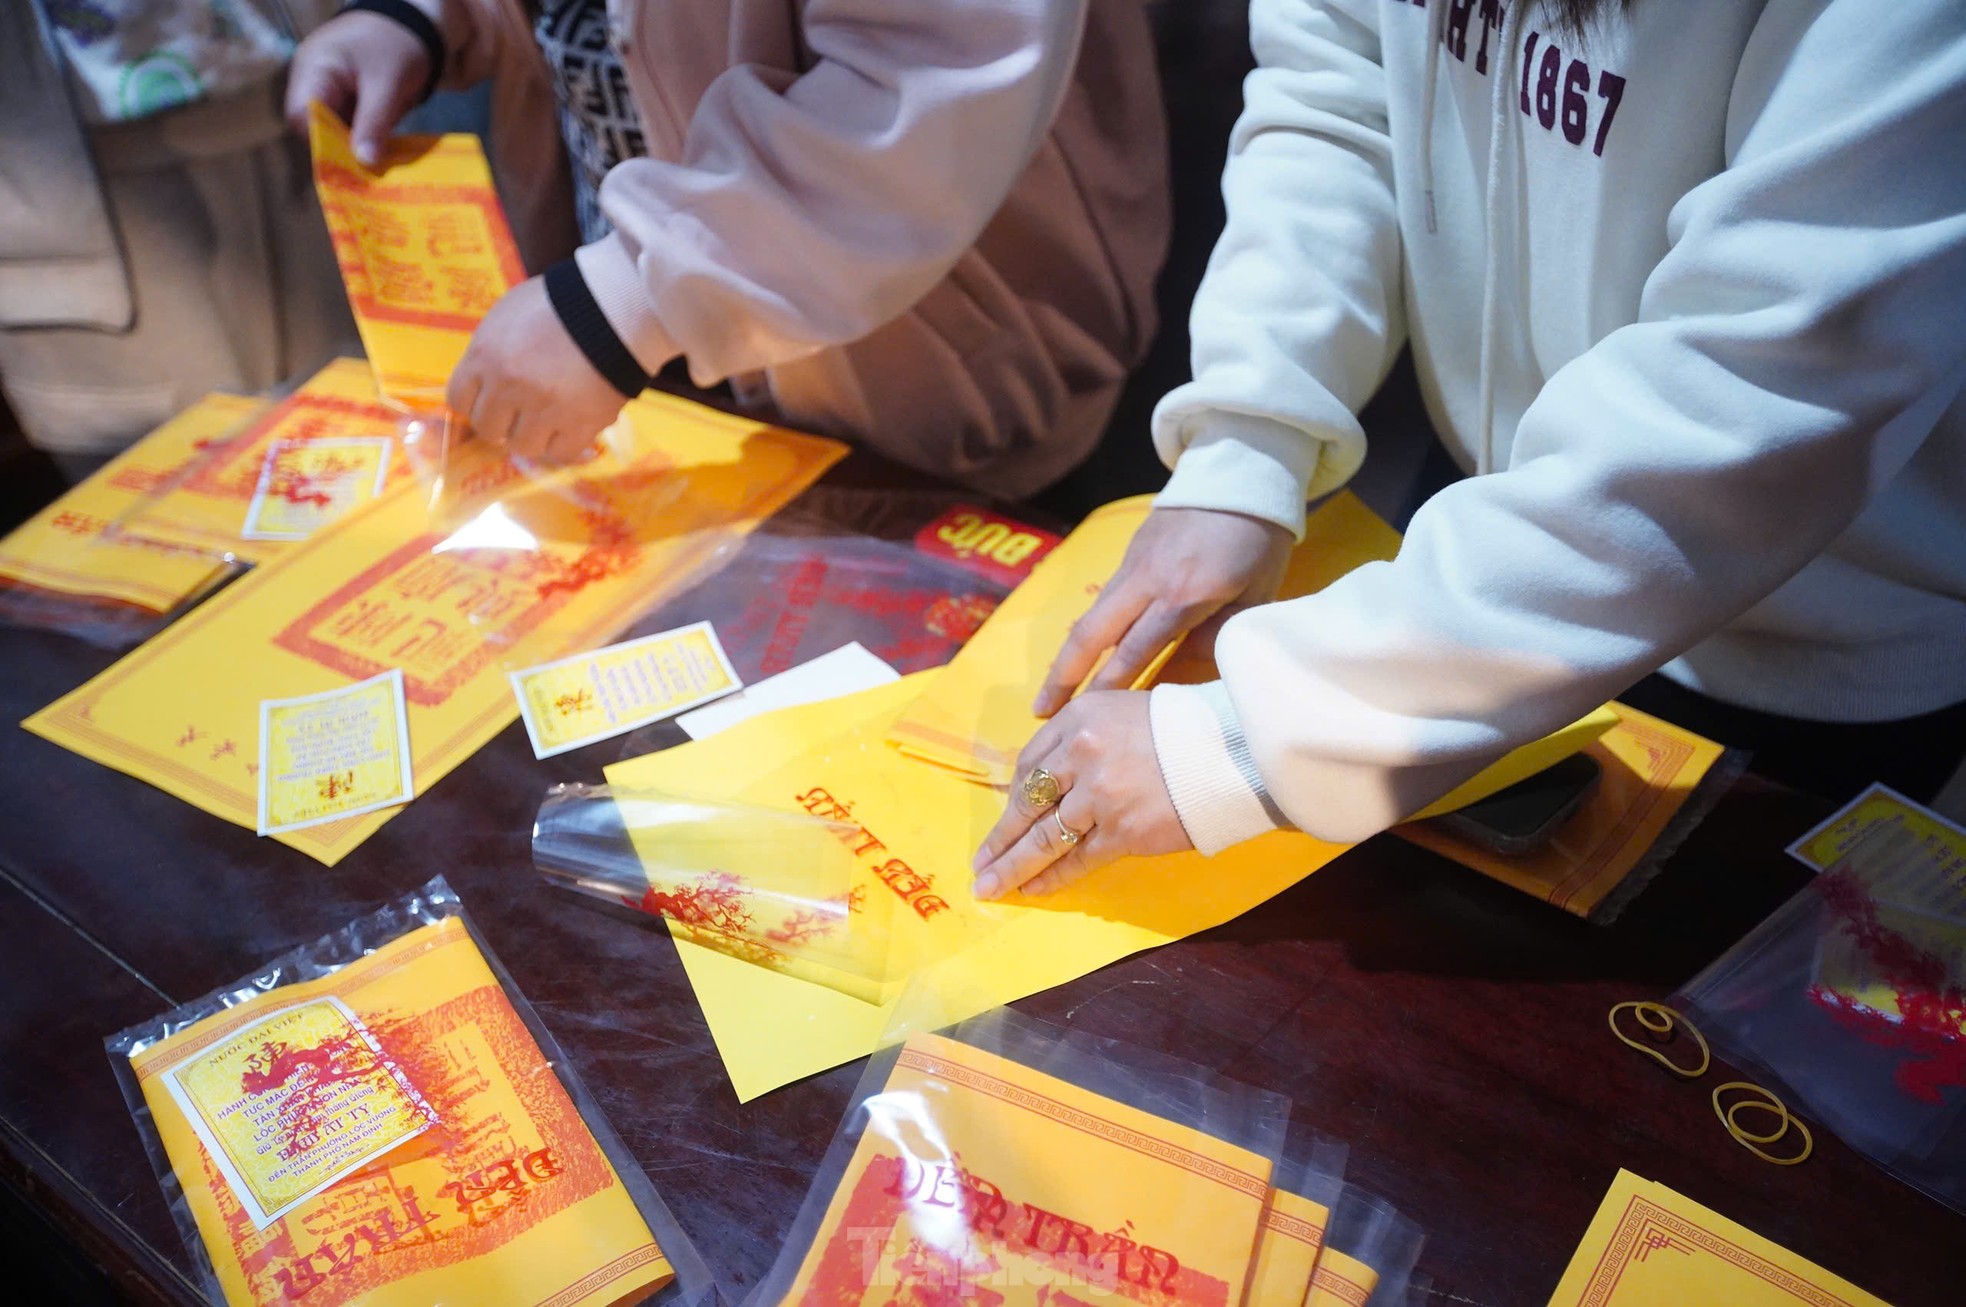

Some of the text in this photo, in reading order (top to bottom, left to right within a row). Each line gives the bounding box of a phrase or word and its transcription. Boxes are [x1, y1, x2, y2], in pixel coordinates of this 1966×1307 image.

[1520, 31, 1626, 157] 1867
[253, 1124, 276, 1142] LỘC
[342, 1134, 361, 1148] NAM
[1022, 1202, 1181, 1293] TRẦN
